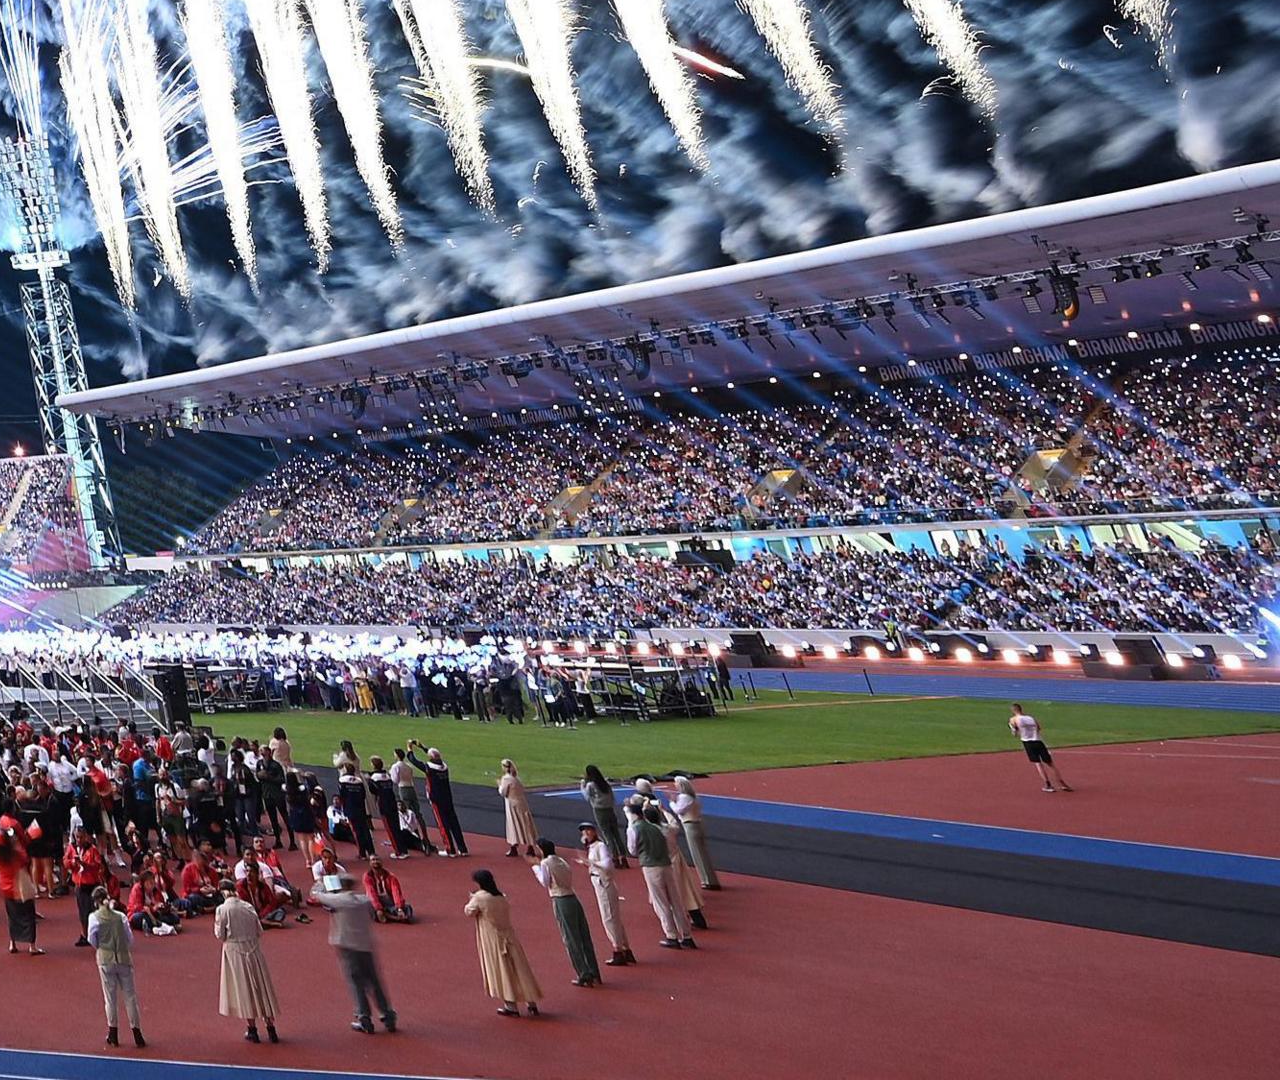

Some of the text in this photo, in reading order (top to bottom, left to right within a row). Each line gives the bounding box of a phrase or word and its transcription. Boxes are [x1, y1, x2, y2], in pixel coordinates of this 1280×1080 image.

[1076, 329, 1183, 358] BIRMINGHAM
[1190, 320, 1280, 344] BIRMINGH
[879, 358, 966, 381] BIRMINGHAM
[972, 344, 1069, 370] BIRMINGHAM
